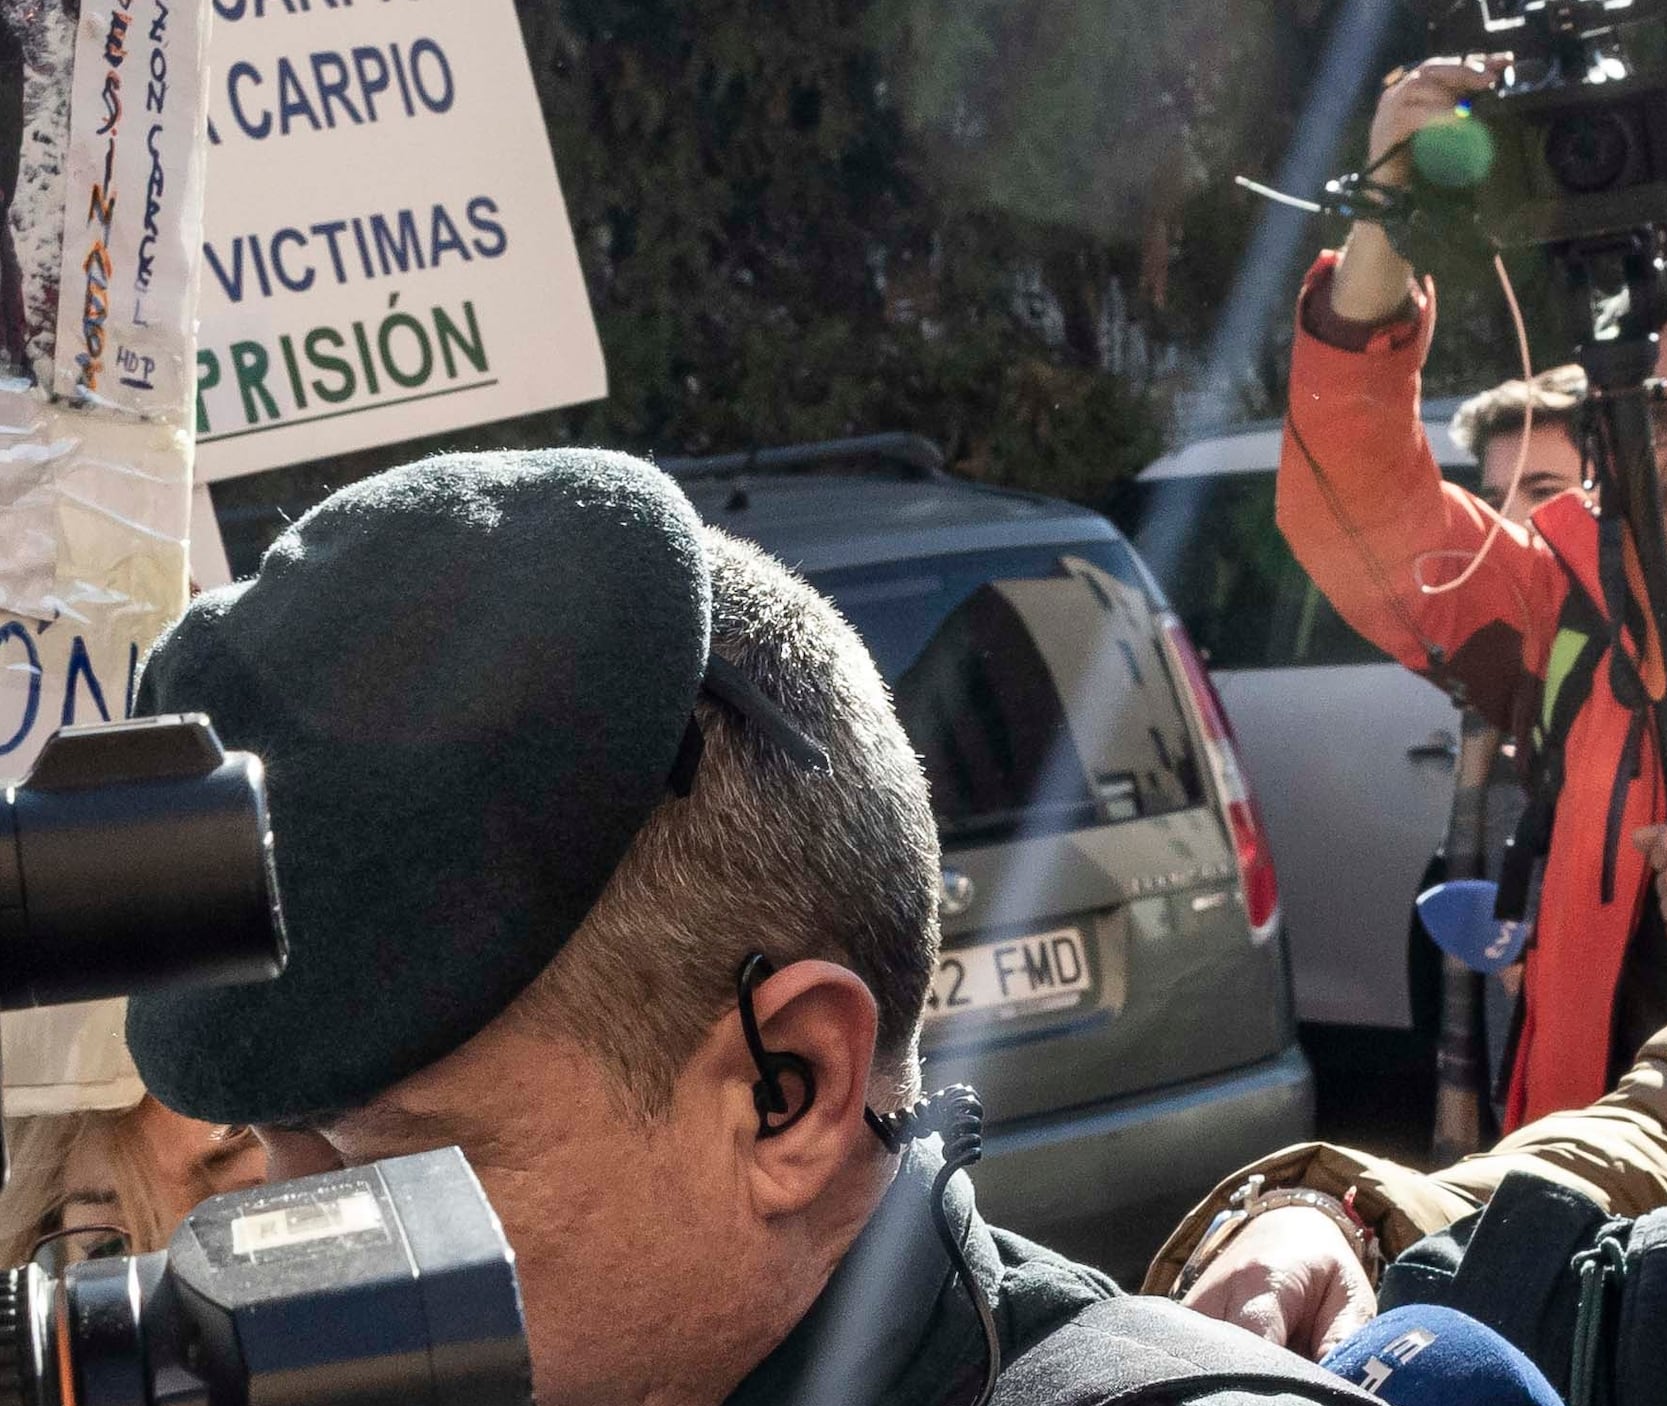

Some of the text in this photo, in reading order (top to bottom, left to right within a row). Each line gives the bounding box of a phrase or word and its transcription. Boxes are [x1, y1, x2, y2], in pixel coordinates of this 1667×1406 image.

[227, 37, 455, 140] CARPIO
[202, 195, 508, 303] VICTIMAS
[195, 290, 489, 433] PRISIÓN
[992, 936, 1082, 998] FMD
